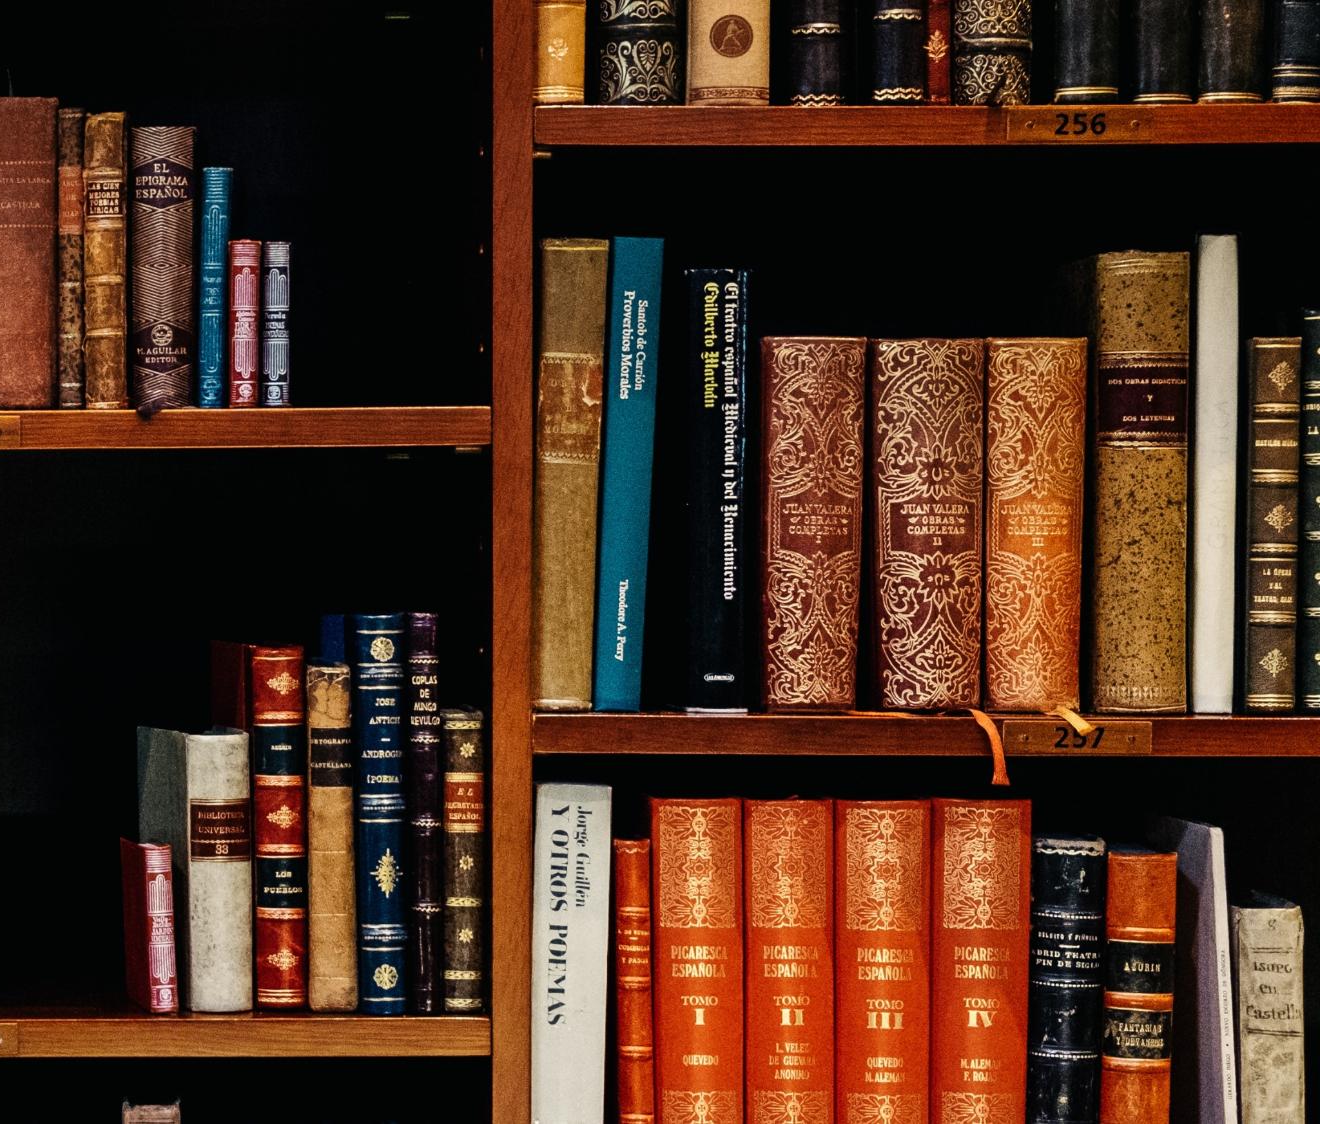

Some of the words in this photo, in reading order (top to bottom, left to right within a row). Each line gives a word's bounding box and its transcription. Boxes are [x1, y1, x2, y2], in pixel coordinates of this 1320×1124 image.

[1055, 112, 1106, 135] 256
[153, 163, 170, 173] EL
[135, 175, 188, 186] EPIGRAMA
[89, 191, 120, 199] MEJORES
[135, 186, 188, 199] ESPAÑOL
[723, 282, 739, 299] El
[636, 299, 648, 336] Santob
[703, 282, 720, 347] Edilberto
[622, 291, 636, 352] Proverbios
[724, 303, 738, 343] teatro
[636, 338, 647, 349] de
[619, 353, 633, 400] Morales
[634, 351, 647, 391] Carrión
[721, 347, 738, 398] español
[1146, 394, 1154, 402] Y
[720, 403, 738, 466] Medieval
[720, 468, 737, 478] y
[724, 481, 739, 499] del
[783, 504, 812, 515] JUAN
[813, 504, 853, 515] VALERA
[900, 504, 930, 515] JUAN
[932, 504, 970, 515] VALERA
[1000, 504, 1030, 515] JUAN
[1032, 504, 1073, 515] VALERA
[804, 515, 838, 525] OBRAS
[922, 515, 955, 525] OBRAS
[1021, 515, 1057, 526] OBRAS
[788, 525, 848, 535] COMPLETAS
[907, 525, 965, 535] COMPLETAS
[1007, 526, 1068, 536] COMPLETAS
[1031, 537, 1044, 547] III
[720, 504, 738, 600] Renacimiento
[617, 579, 629, 623] Theodore
[617, 623, 627, 634] A.
[614, 635, 627, 661] Perry
[410, 675, 438, 686] COPLAS
[419, 689, 430, 699] DE
[375, 698, 396, 707] JOSE
[413, 702, 438, 712] MINGO
[368, 716, 401, 725] ANTICH
[1055, 727, 1105, 748] 257
[456, 787, 474, 796] EL
[198, 811, 246, 820] BIBLIOTECA
[551, 805, 570, 822] Y
[197, 825, 246, 835] UNIVERSAL
[573, 806, 592, 848] Jorge
[215, 844, 229, 855] 33
[275, 871, 293, 879] LOS
[549, 829, 569, 912] OTROS
[574, 852, 591, 908] Guillén
[263, 886, 303, 894] PUEBLOS
[670, 945, 728, 960] PICARESCA
[763, 945, 818, 960] PICARESCA
[857, 947, 914, 963] PICARESCA
[953, 946, 1010, 962] PICARESCA
[547, 923, 568, 1026] POEMAS
[671, 962, 726, 978] ESPAÑOLA
[764, 963, 818, 978] ESPAÑOLA
[858, 965, 912, 981] ESPAÑOLA
[955, 964, 1008, 980] ESPAÑOLA
[681, 996, 718, 1007] TOMO
[773, 996, 810, 1007] TOMO
[866, 998, 904, 1010] TOMO
[963, 998, 1000, 1010] TOMO
[694, 1008, 705, 1026] I
[780, 1008, 804, 1026] II
[866, 1011, 905, 1030] III
[967, 1010, 998, 1028] IV
[682, 1055, 719, 1066] QUEVEDO
[768, 1055, 780, 1066] DE
[867, 1057, 904, 1069] QUEVEDO
